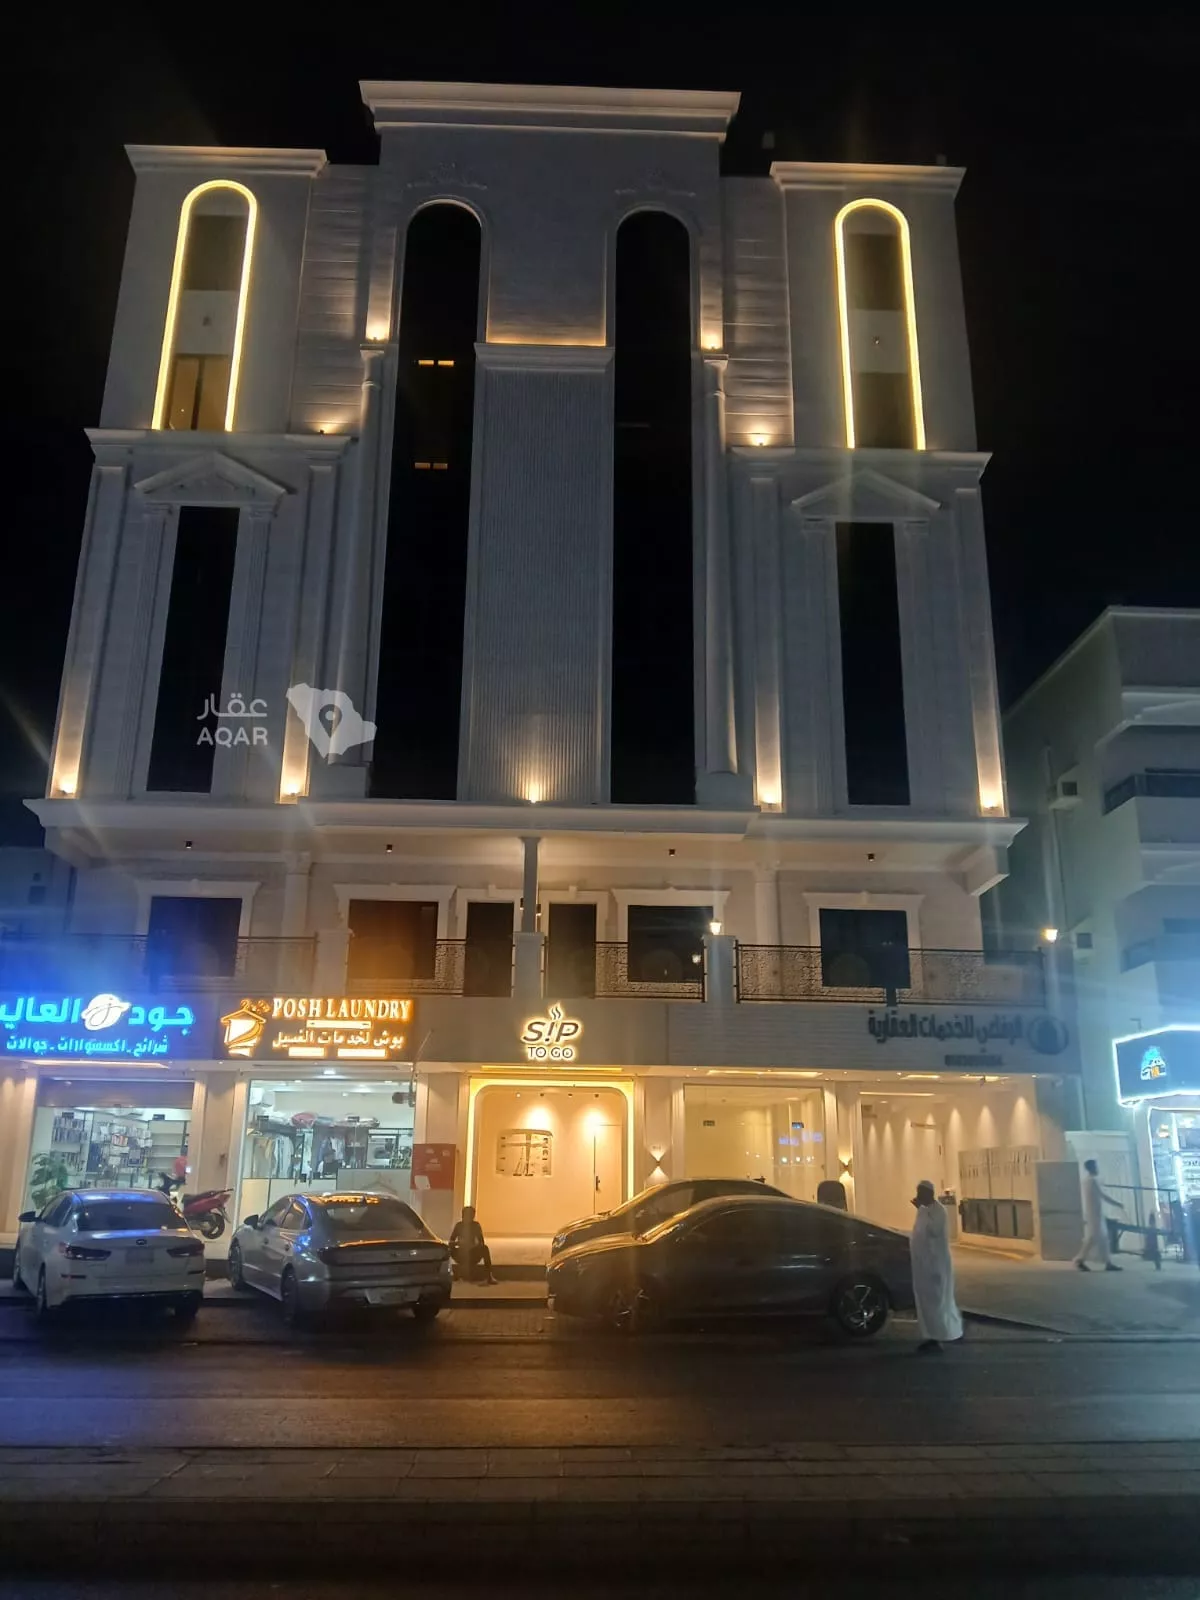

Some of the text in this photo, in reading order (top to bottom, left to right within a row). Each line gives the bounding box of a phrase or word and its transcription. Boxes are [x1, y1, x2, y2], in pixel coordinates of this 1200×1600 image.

[0, 997, 195, 1035] جود العالي
[272, 998, 412, 1019] POSH LAUNDRY
[868, 1010, 918, 1043] العقارية
[919, 1014, 974, 1041] للخدمات
[272, 1030, 404, 1048] بوش لخدمات الغسيل
[528, 1046, 574, 1058] TO GO
